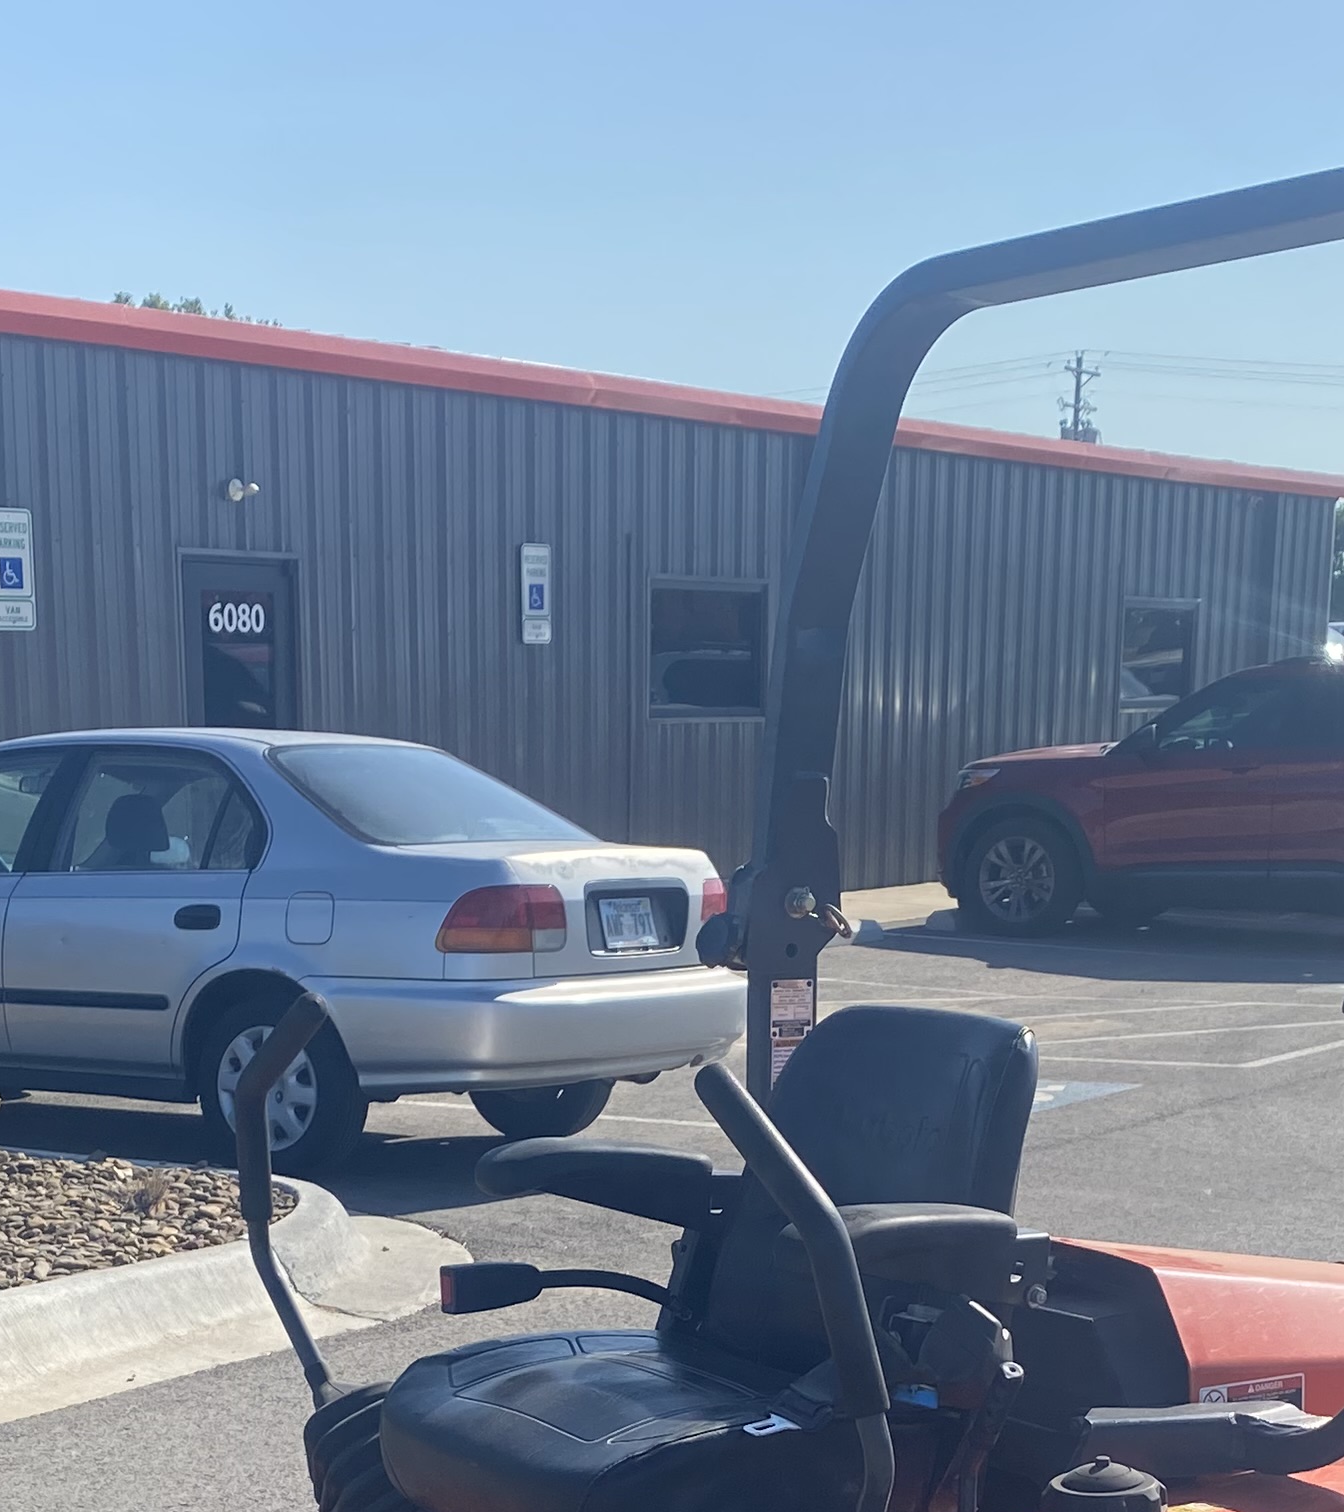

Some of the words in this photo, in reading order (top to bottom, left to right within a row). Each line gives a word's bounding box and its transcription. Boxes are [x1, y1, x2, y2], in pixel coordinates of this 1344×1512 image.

[4, 605, 21, 615] VAN
[208, 602, 265, 633] 6080
[1255, 1380, 1283, 1392] DANGER
